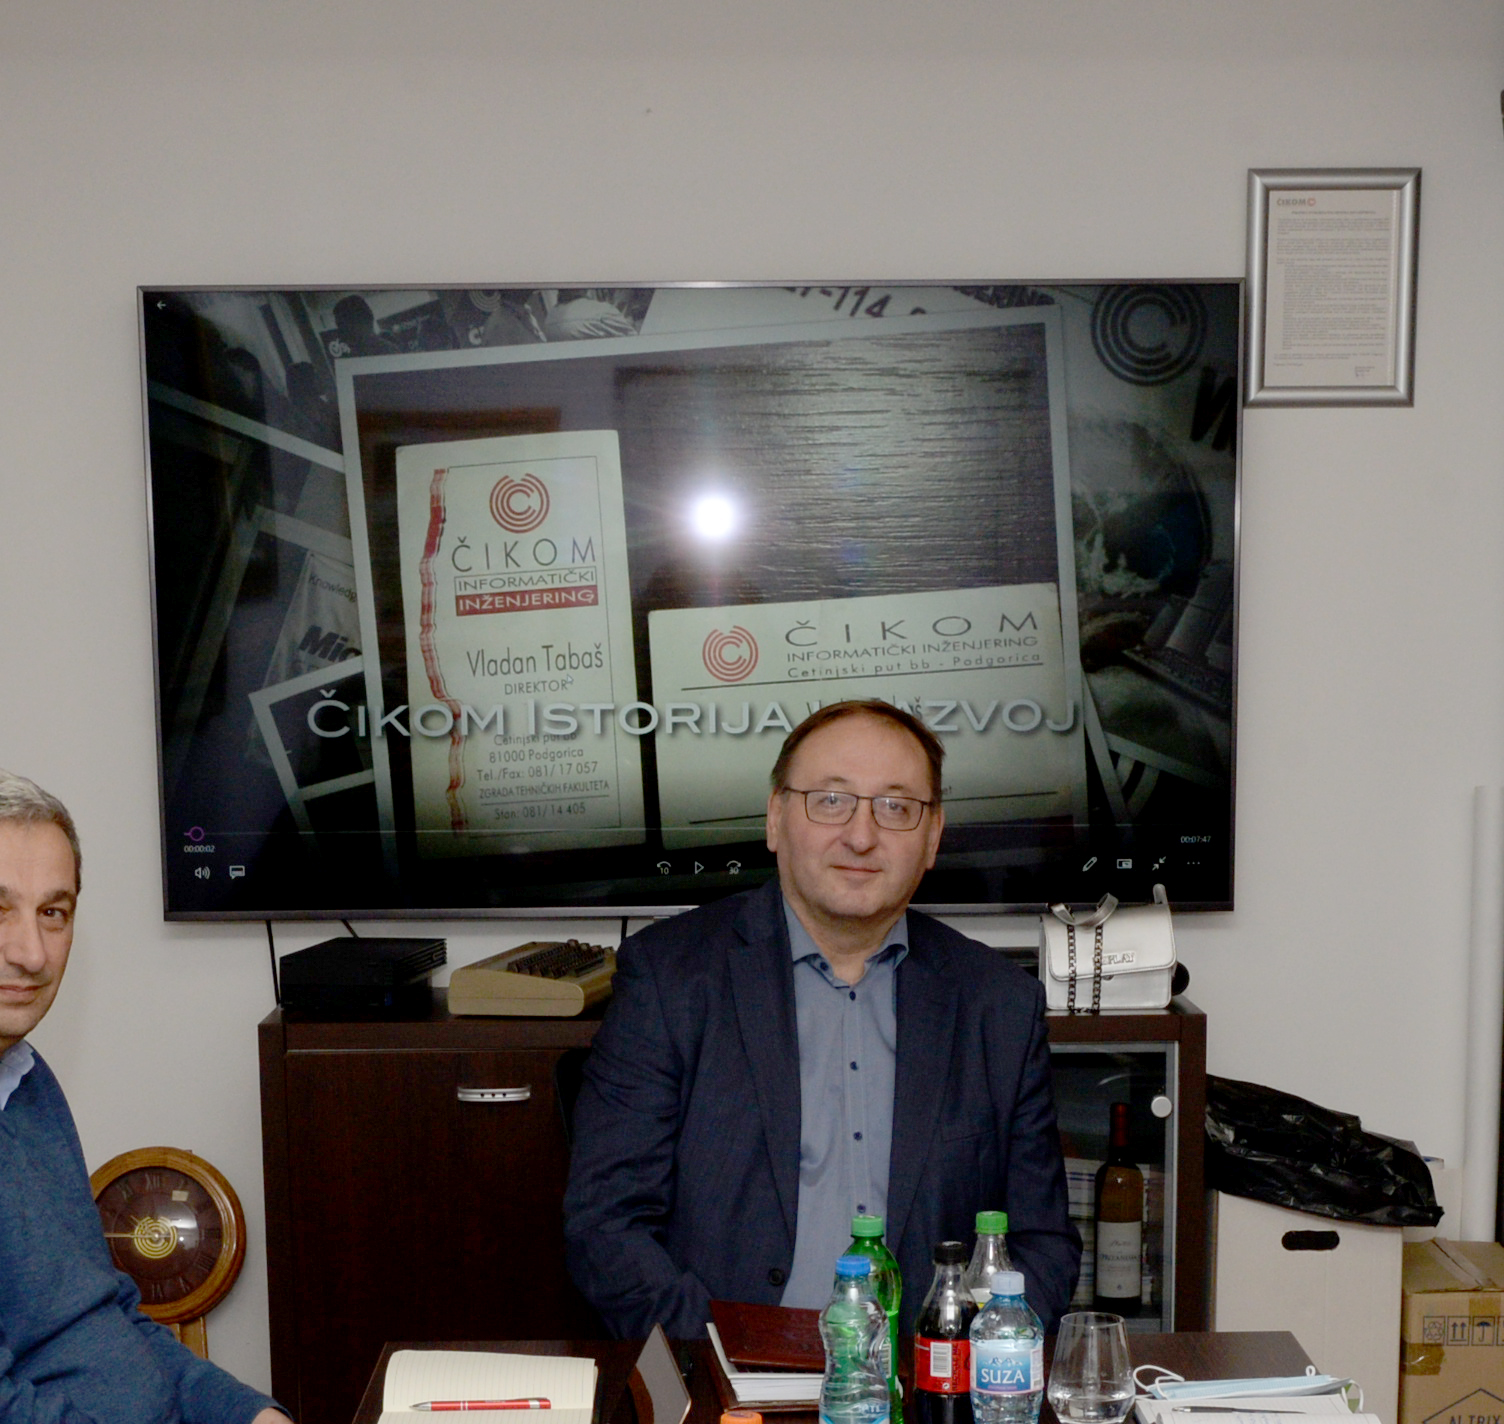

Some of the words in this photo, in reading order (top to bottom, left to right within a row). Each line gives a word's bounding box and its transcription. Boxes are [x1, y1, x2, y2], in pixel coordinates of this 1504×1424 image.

[452, 536, 596, 572] ČIKOM
[458, 568, 595, 592] INFORMATIČKI
[459, 589, 595, 612] INŽENJERING
[785, 611, 1038, 647] ČIKOM
[467, 646, 537, 677] Vladan
[541, 642, 604, 671] Tabaš
[786, 643, 917, 664] INFORMATIČKI
[922, 635, 1039, 655] INŽENJERING
[787, 663, 866, 680] Cetinjski
[874, 661, 903, 676] put
[909, 658, 931, 671] bb
[953, 652, 1041, 669] Podgorica
[504, 679, 569, 696] DIREKTOR
[307, 689, 505, 739] ČIKOM
[528, 699, 794, 738] ISTORIJA
[489, 751, 526, 763] 81000
[981, 1368, 1025, 1384] SUZA
